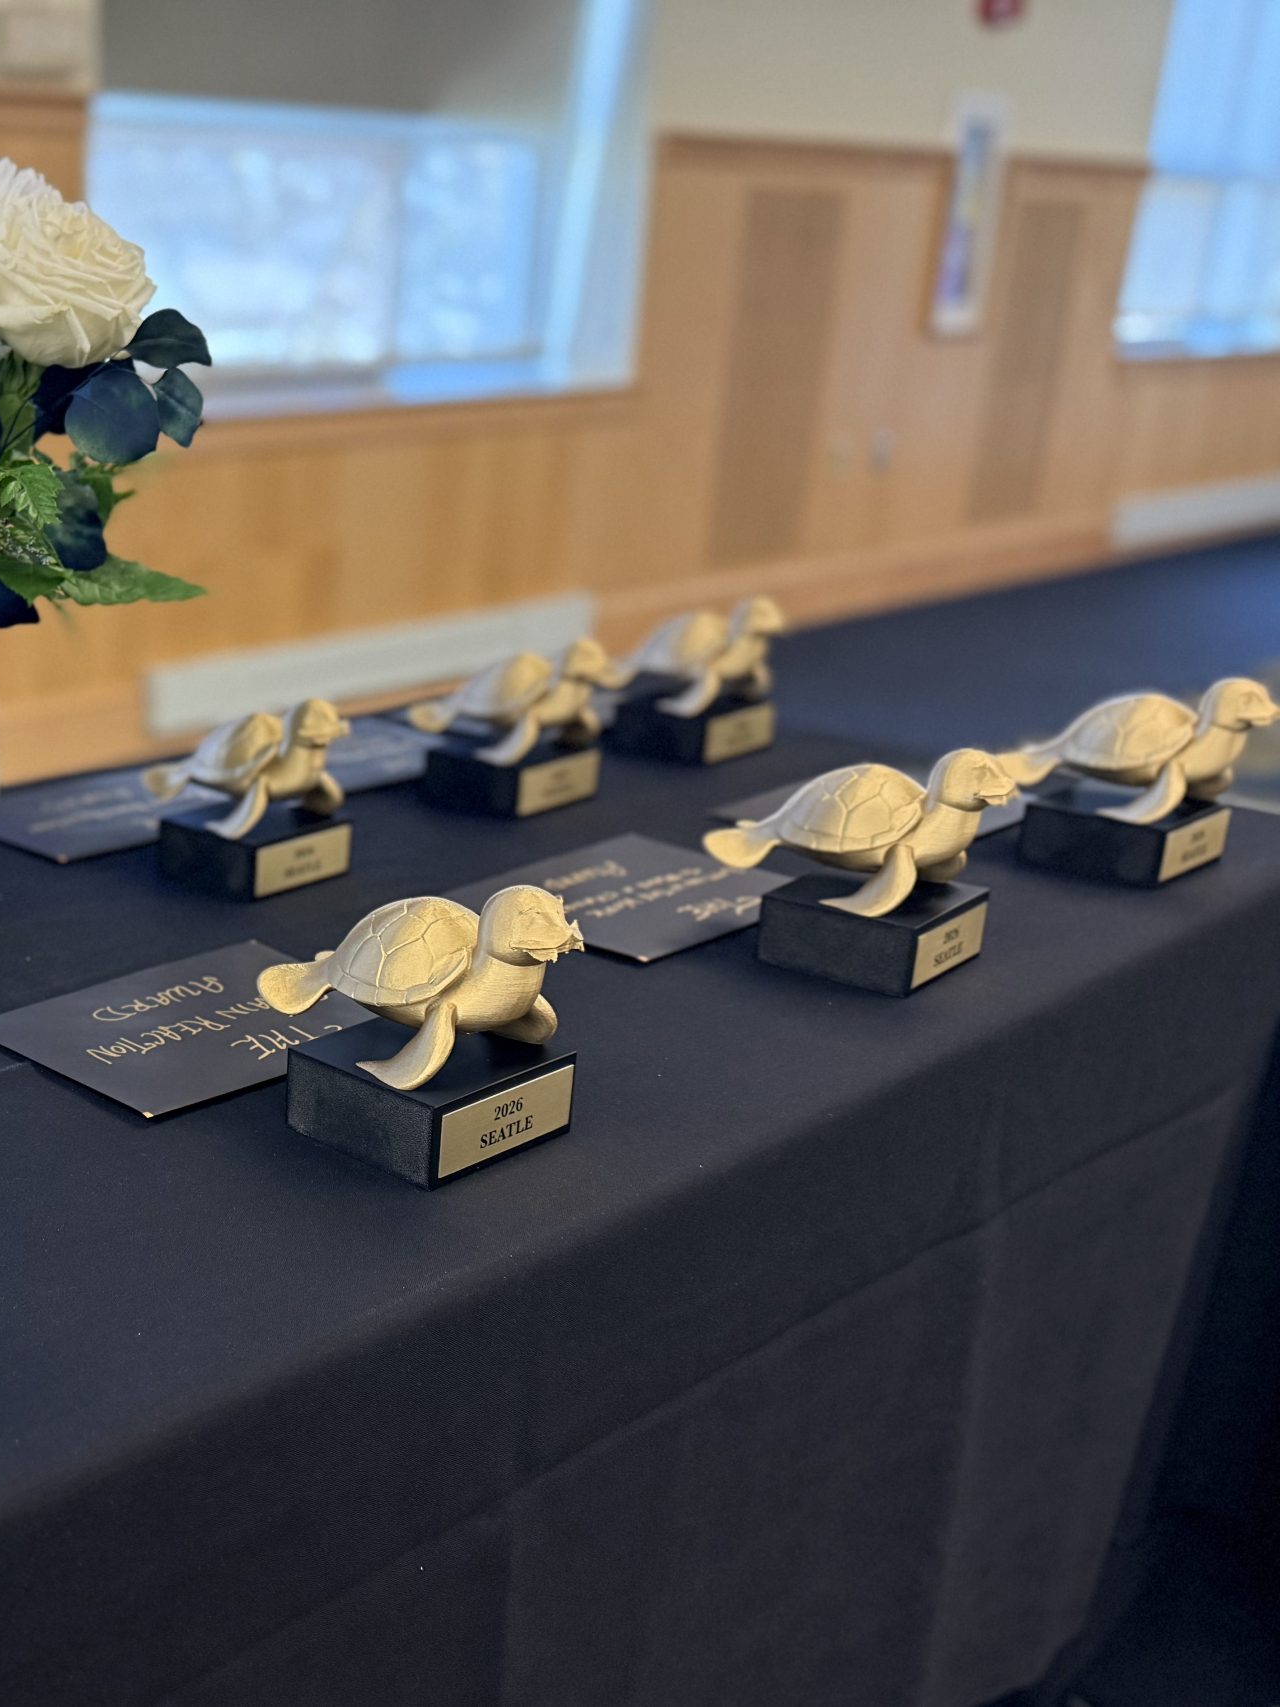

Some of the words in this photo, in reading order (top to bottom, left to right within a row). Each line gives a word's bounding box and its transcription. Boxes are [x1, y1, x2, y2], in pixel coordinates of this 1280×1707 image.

[92, 975, 225, 1022] AWARD
[85, 1015, 231, 1064] REACTION
[494, 1097, 523, 1121] 2026
[480, 1115, 533, 1149] SEATLE
